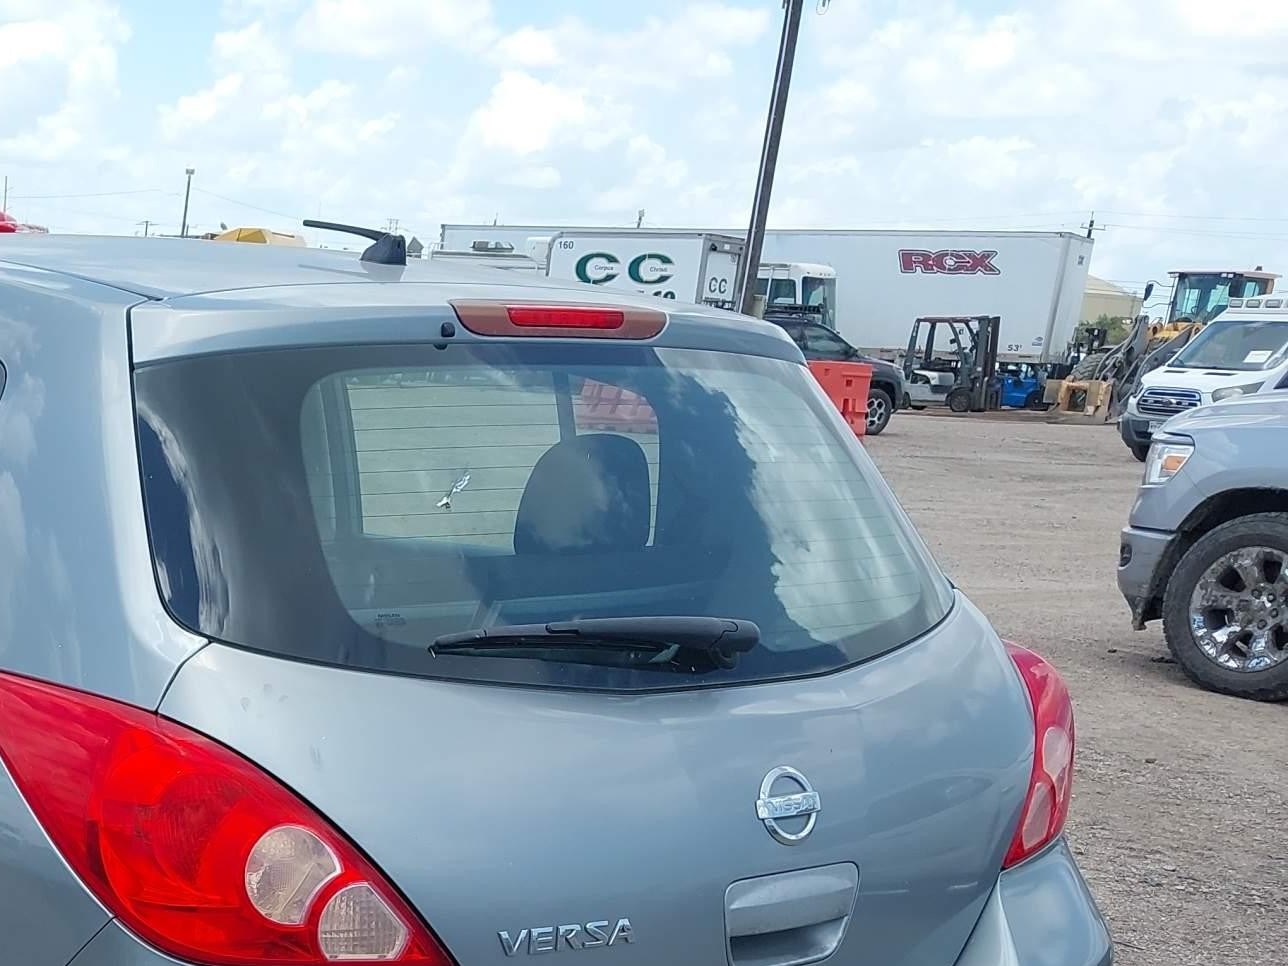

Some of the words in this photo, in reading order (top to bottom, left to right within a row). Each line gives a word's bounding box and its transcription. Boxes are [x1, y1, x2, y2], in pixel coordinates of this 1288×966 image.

[559, 240, 574, 249] 160
[898, 249, 1001, 275] RCX
[497, 917, 635, 956] VERSA
